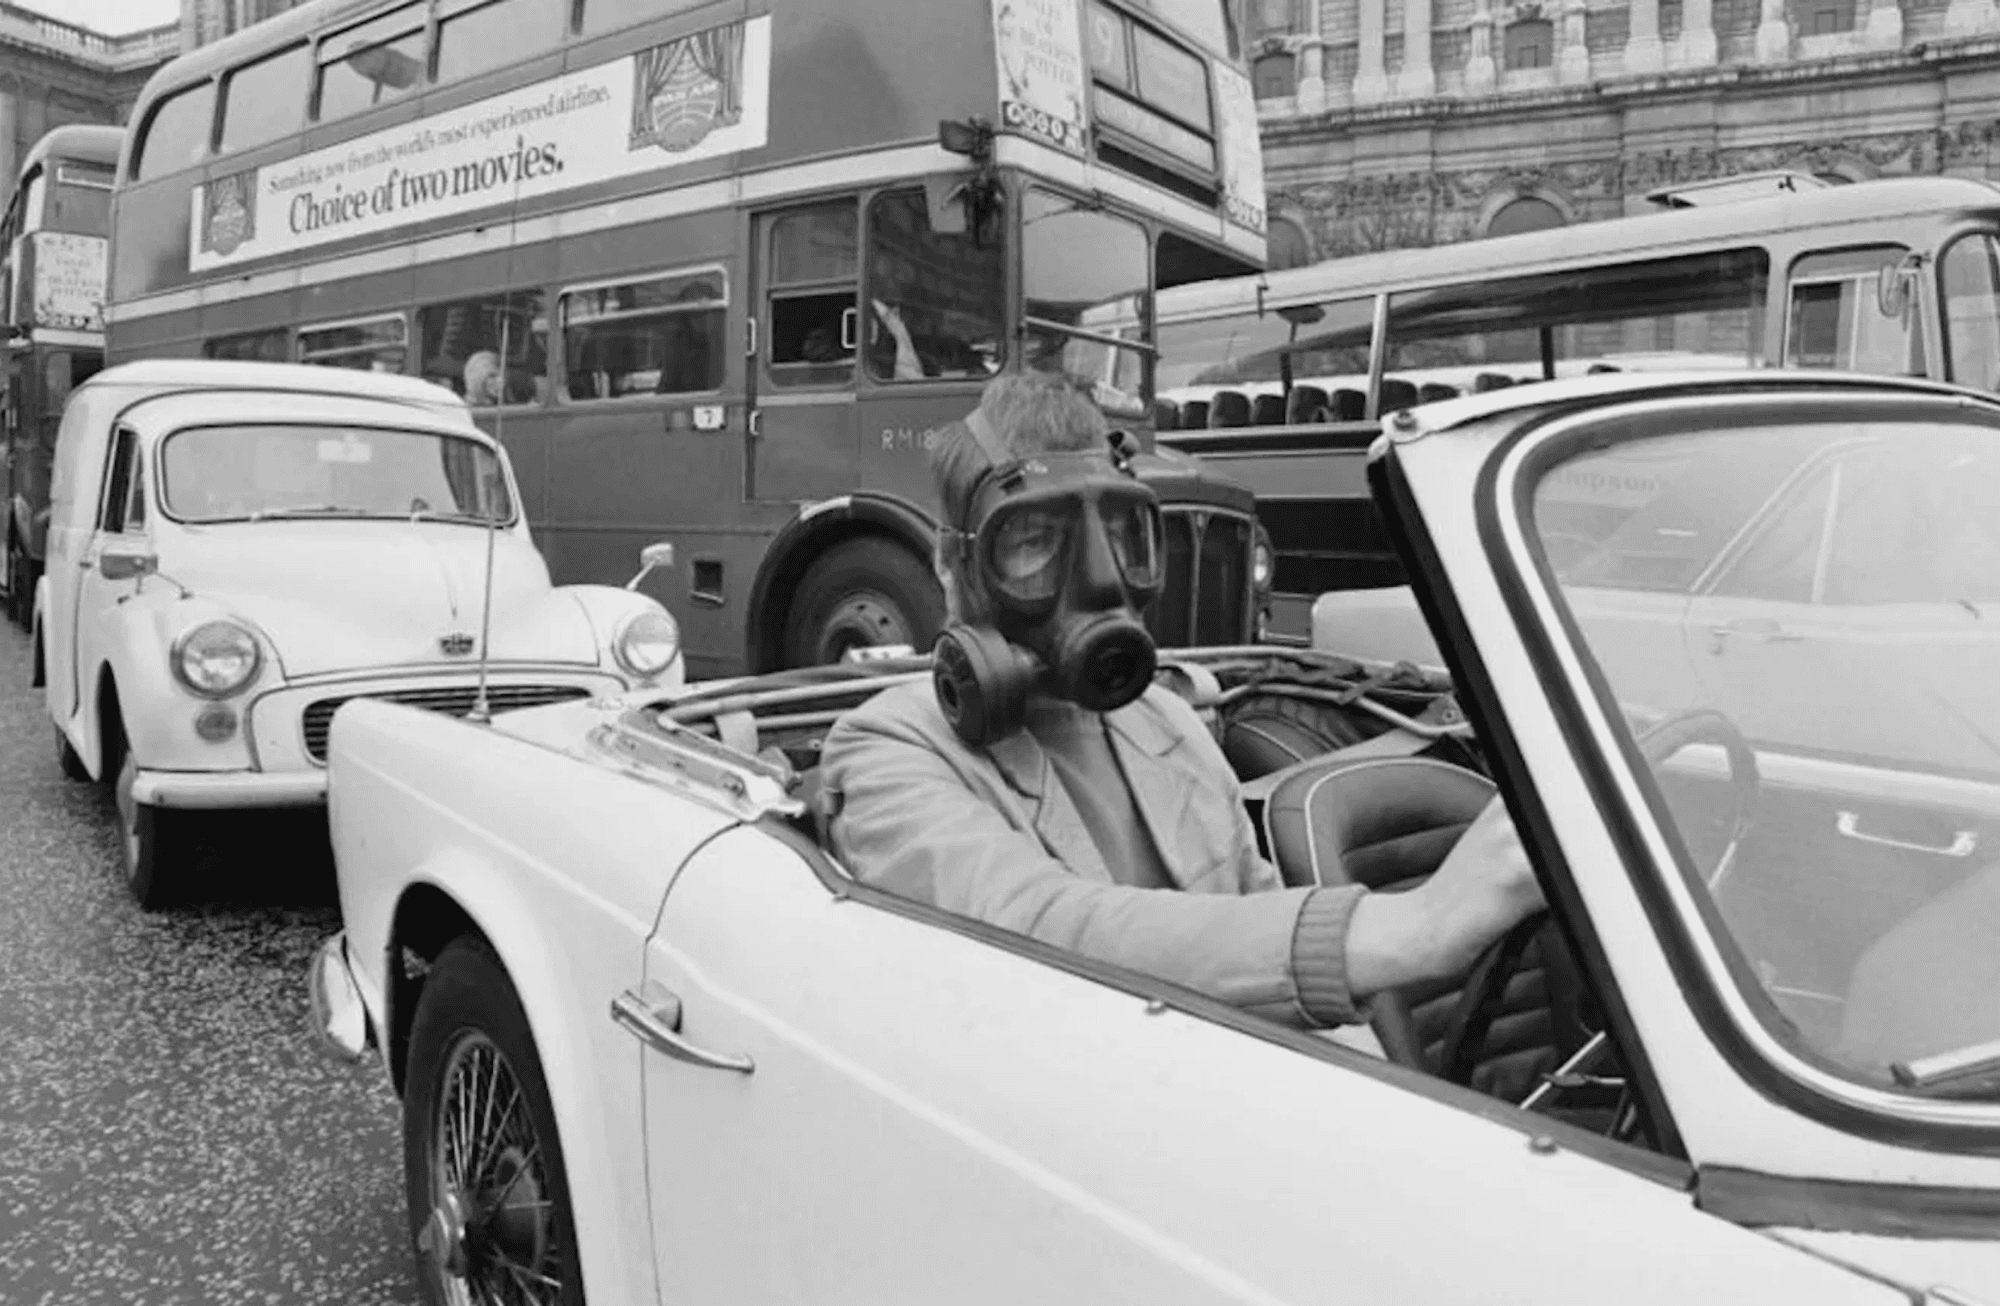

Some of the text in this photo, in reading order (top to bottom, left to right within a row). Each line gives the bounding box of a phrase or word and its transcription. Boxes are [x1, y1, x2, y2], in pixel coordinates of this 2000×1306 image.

[1095, 13, 1114, 67] 9
[470, 92, 554, 139] experienced
[289, 138, 565, 235] Choice of two movies.
